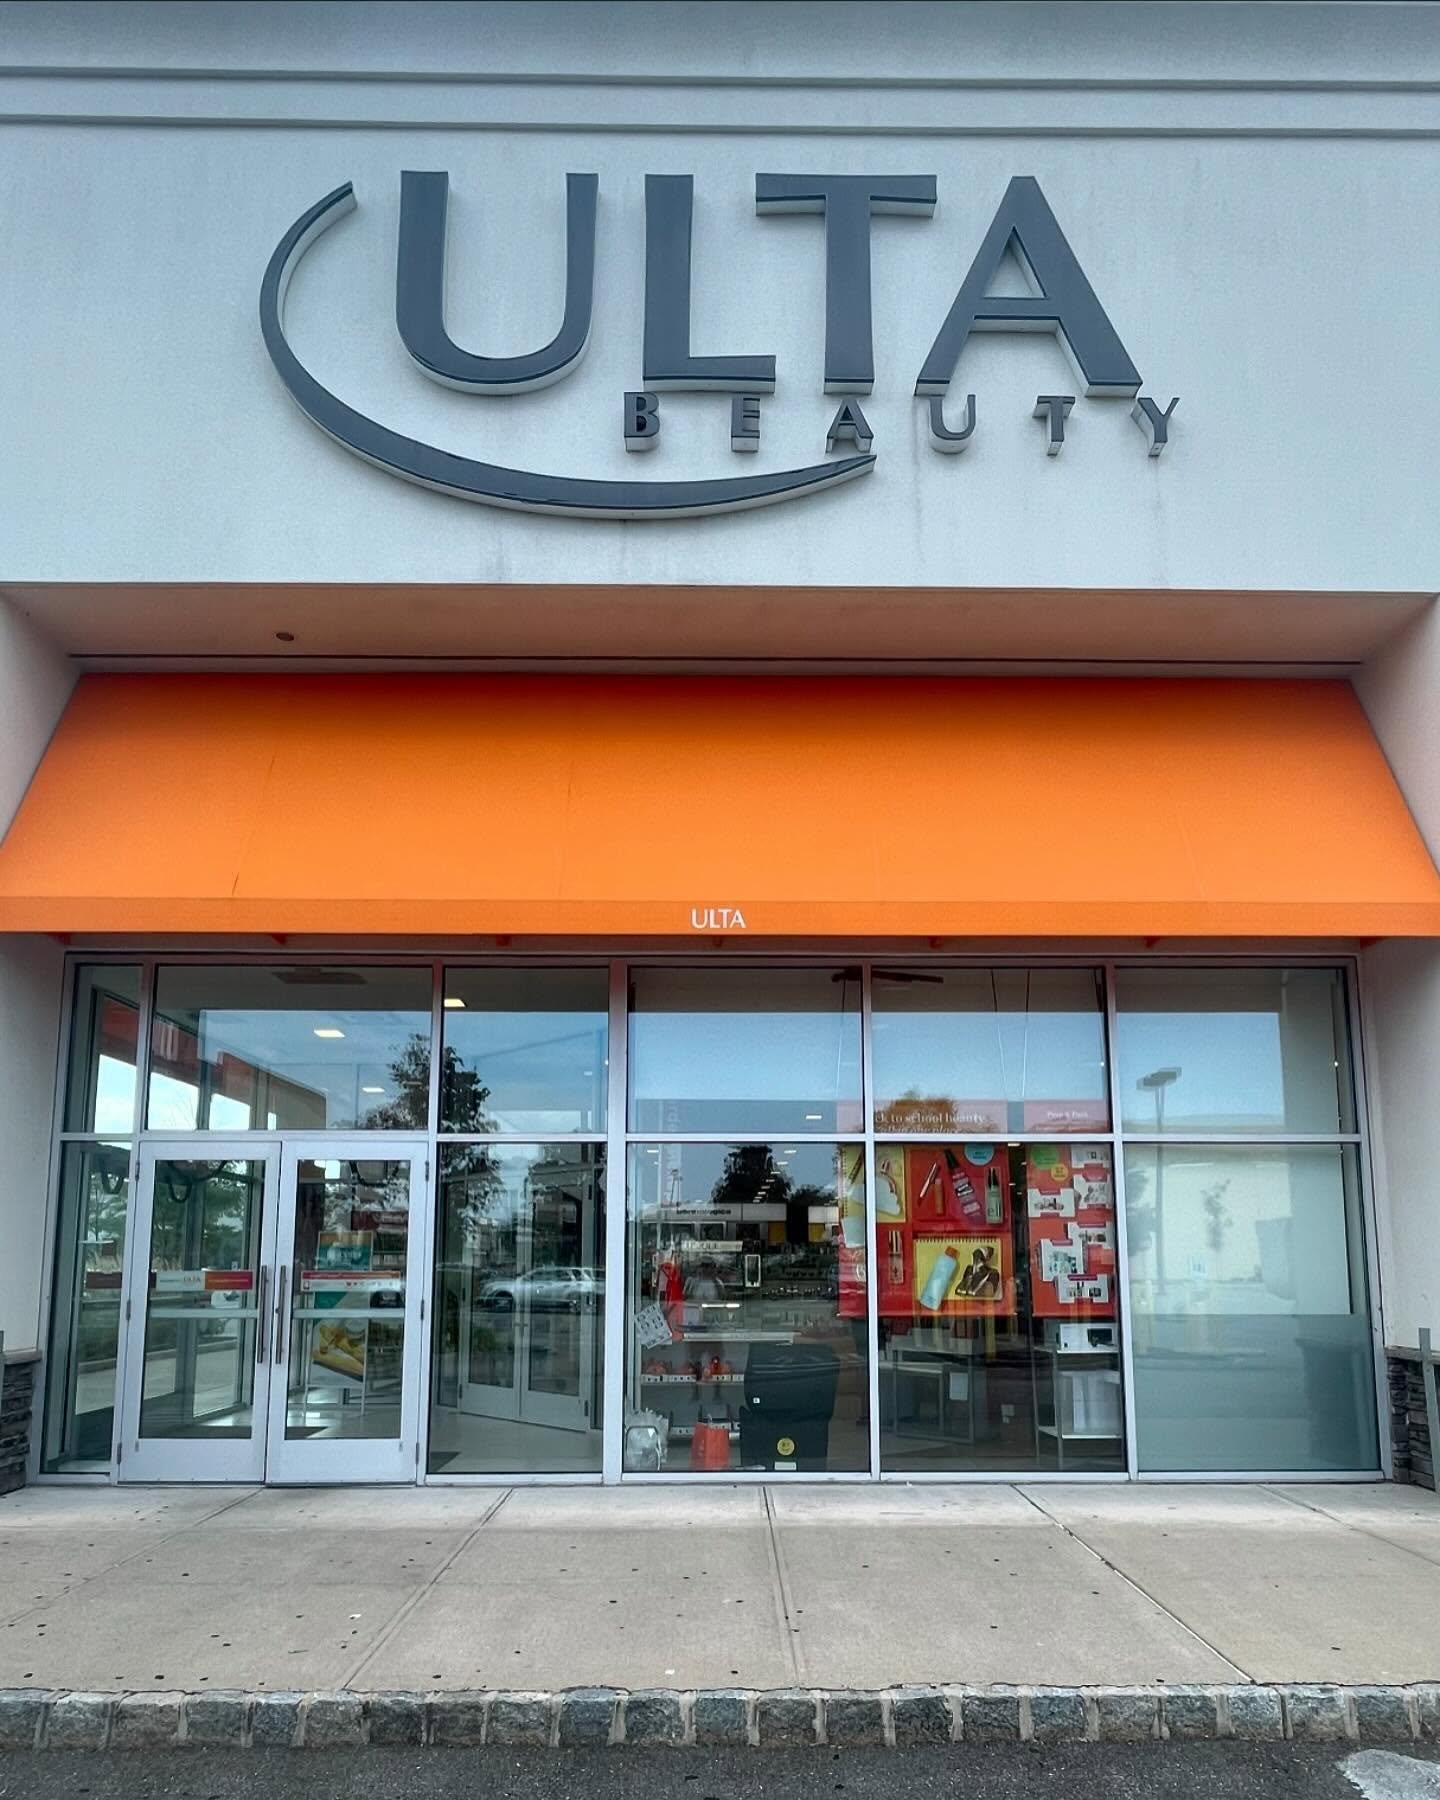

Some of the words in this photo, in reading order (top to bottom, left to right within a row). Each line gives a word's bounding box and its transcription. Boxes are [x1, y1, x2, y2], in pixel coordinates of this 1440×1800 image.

[396, 170, 1143, 397] ULTA
[624, 391, 1180, 455] BEAUTY
[691, 908, 747, 929] ULTA
[905, 1111, 943, 1122] school
